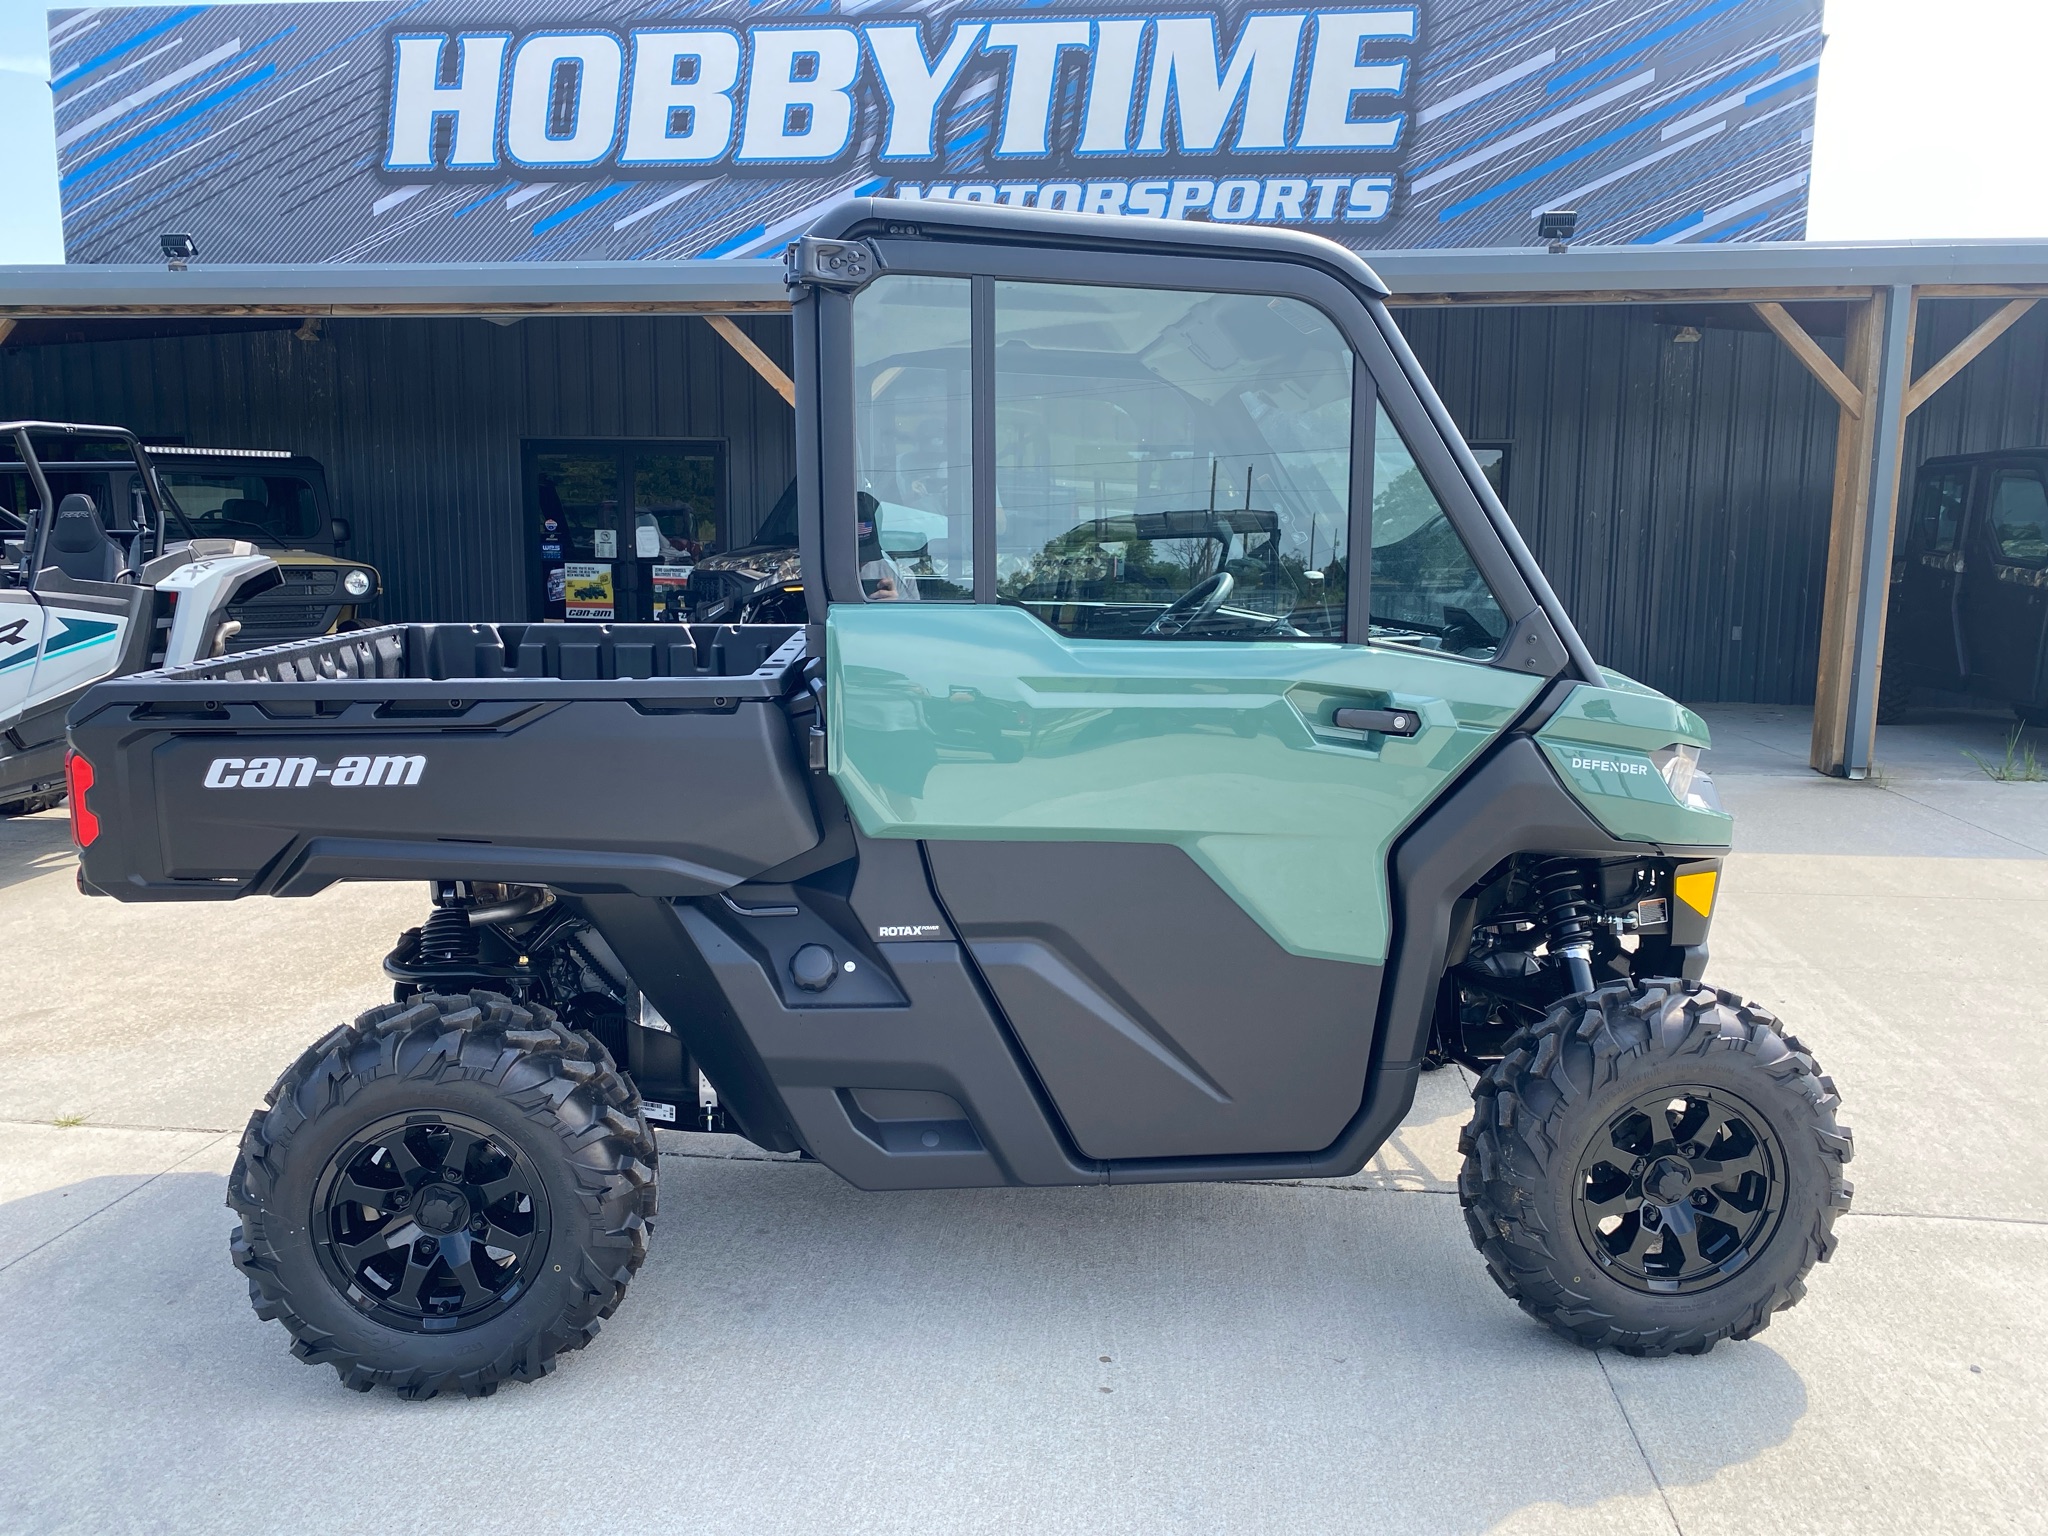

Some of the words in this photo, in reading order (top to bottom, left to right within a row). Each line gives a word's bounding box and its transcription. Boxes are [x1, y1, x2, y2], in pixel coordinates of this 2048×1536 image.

[384, 9, 1416, 170] HOBBYTIME
[568, 609, 612, 617] can-am
[203, 755, 428, 788] can-am
[1571, 757, 1648, 775] DEFENDER
[879, 926, 922, 936] ROTAX
